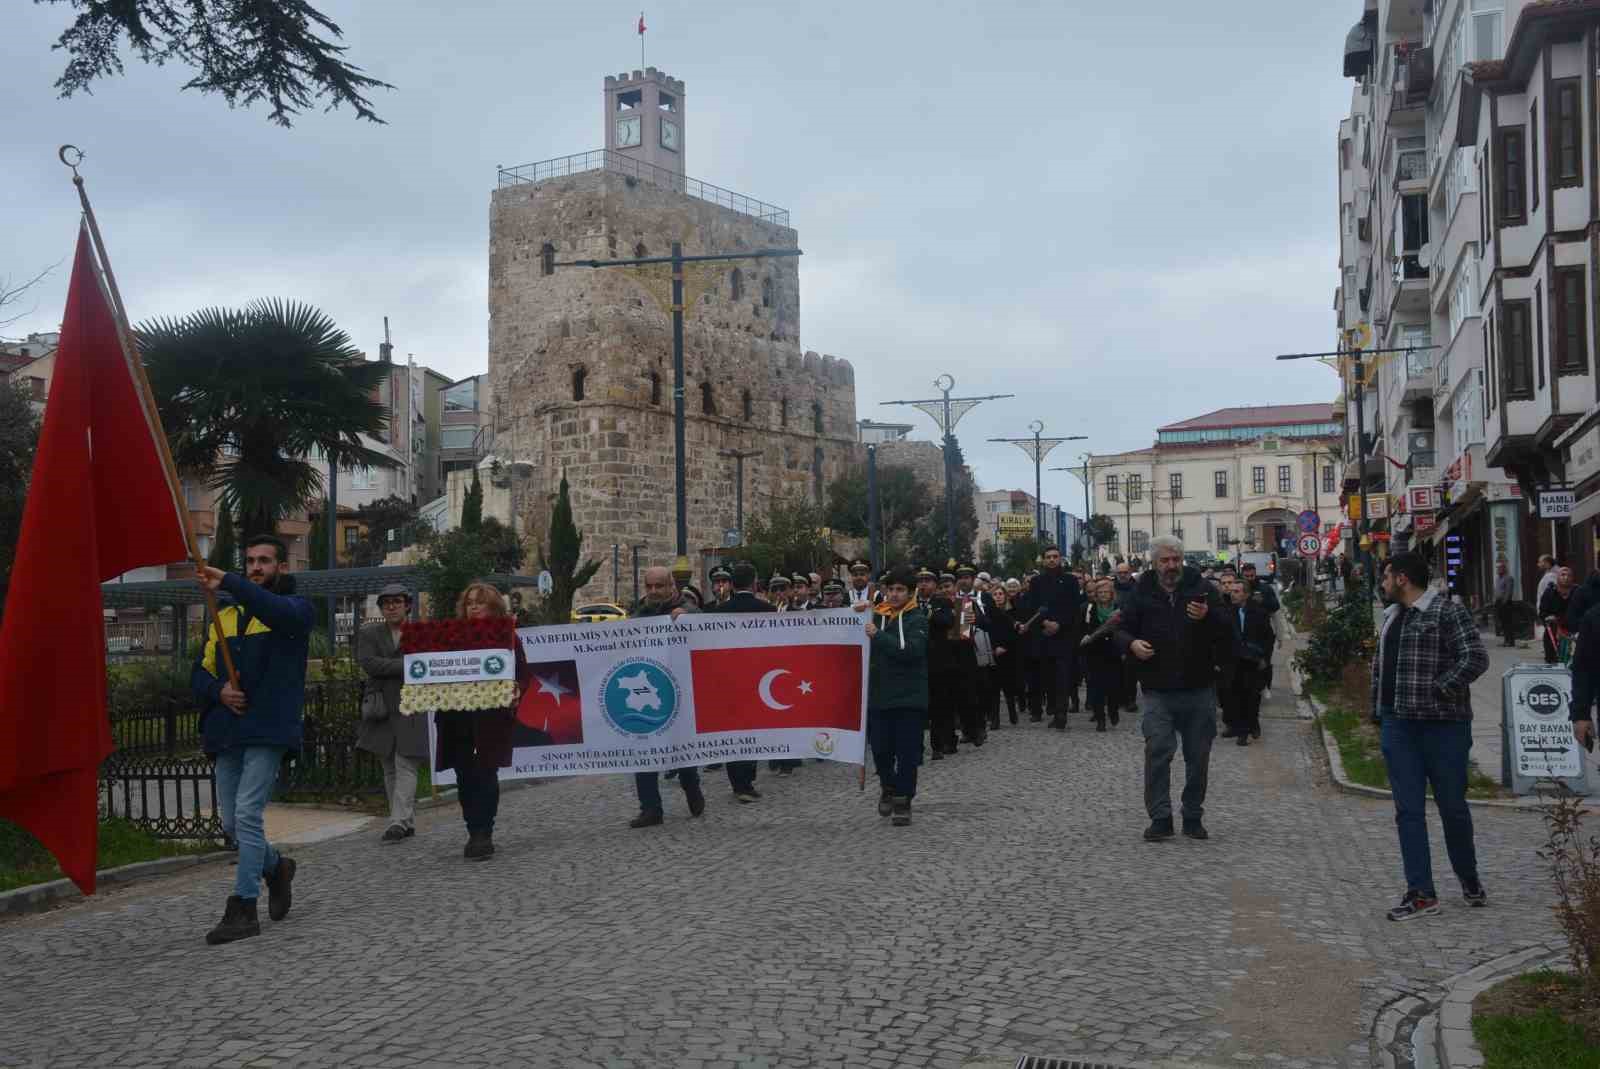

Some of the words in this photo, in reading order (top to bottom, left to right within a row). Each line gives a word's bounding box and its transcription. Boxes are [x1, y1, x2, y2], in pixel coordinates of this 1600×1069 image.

[1415, 492, 1428, 505] E
[1542, 495, 1574, 504] NAMLI
[1546, 504, 1570, 513] PİDE
[1303, 540, 1317, 551] 30
[602, 626, 641, 639] VATAN
[643, 621, 736, 636] TOPRAKLARININ
[740, 617, 767, 630] AZİZ
[574, 641, 616, 654] M.Kemal
[619, 637, 665, 650] ATATÜRK
[667, 635, 688, 647] 1931
[1529, 693, 1559, 705] DES
[1520, 724, 1538, 733] BAY
[1540, 723, 1572, 733] BAYAN
[1552, 735, 1574, 745] TAKI
[541, 751, 574, 762] SİNOP
[576, 748, 636, 760] MÜBADELE
[650, 743, 694, 756] BALKAN
[697, 736, 757, 749] HALKLARI
[515, 761, 561, 774] KÜLTÜR
[564, 758, 651, 772] ARAŞTIRMALARI
[654, 756, 667, 766] VE
[671, 749, 737, 764] DAYANIŞMA
[740, 743, 791, 756] DERNEĞİ
